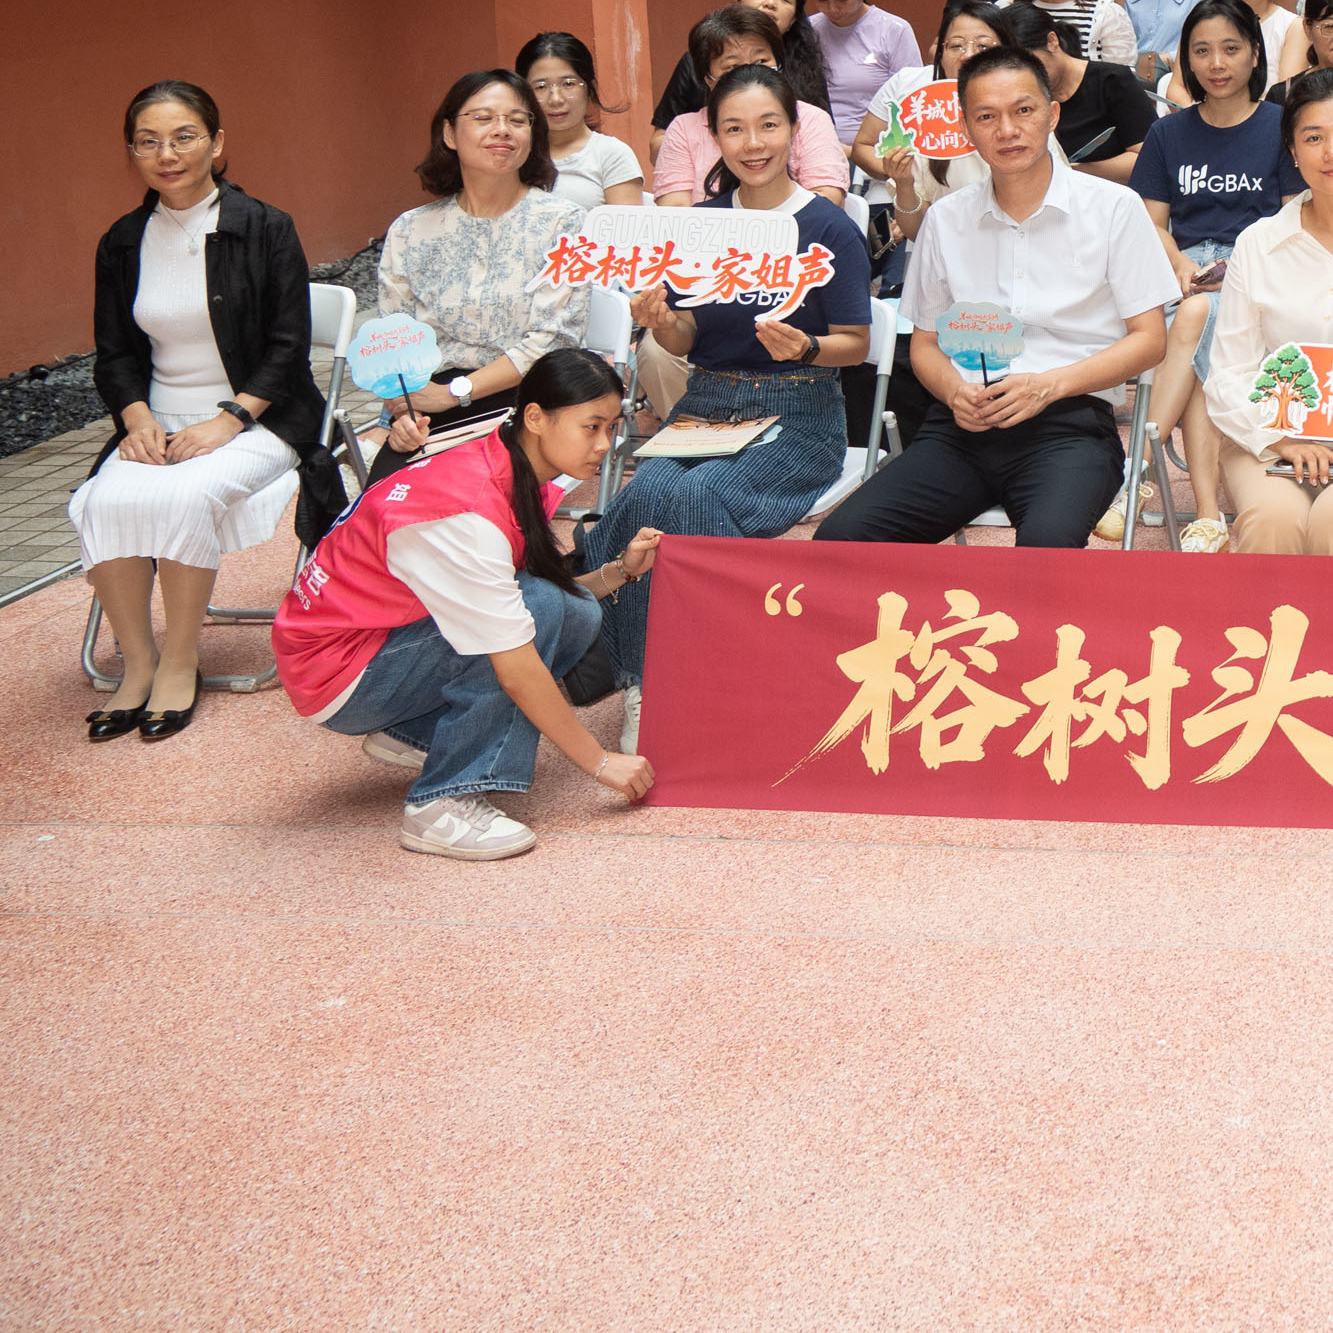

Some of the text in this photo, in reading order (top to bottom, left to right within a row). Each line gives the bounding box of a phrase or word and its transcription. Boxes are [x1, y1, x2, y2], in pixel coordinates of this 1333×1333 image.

[904, 90, 962, 136] 羊城巾
[1207, 169, 1263, 193] GBAx
[543, 236, 832, 318] 榕树头·家姐声
